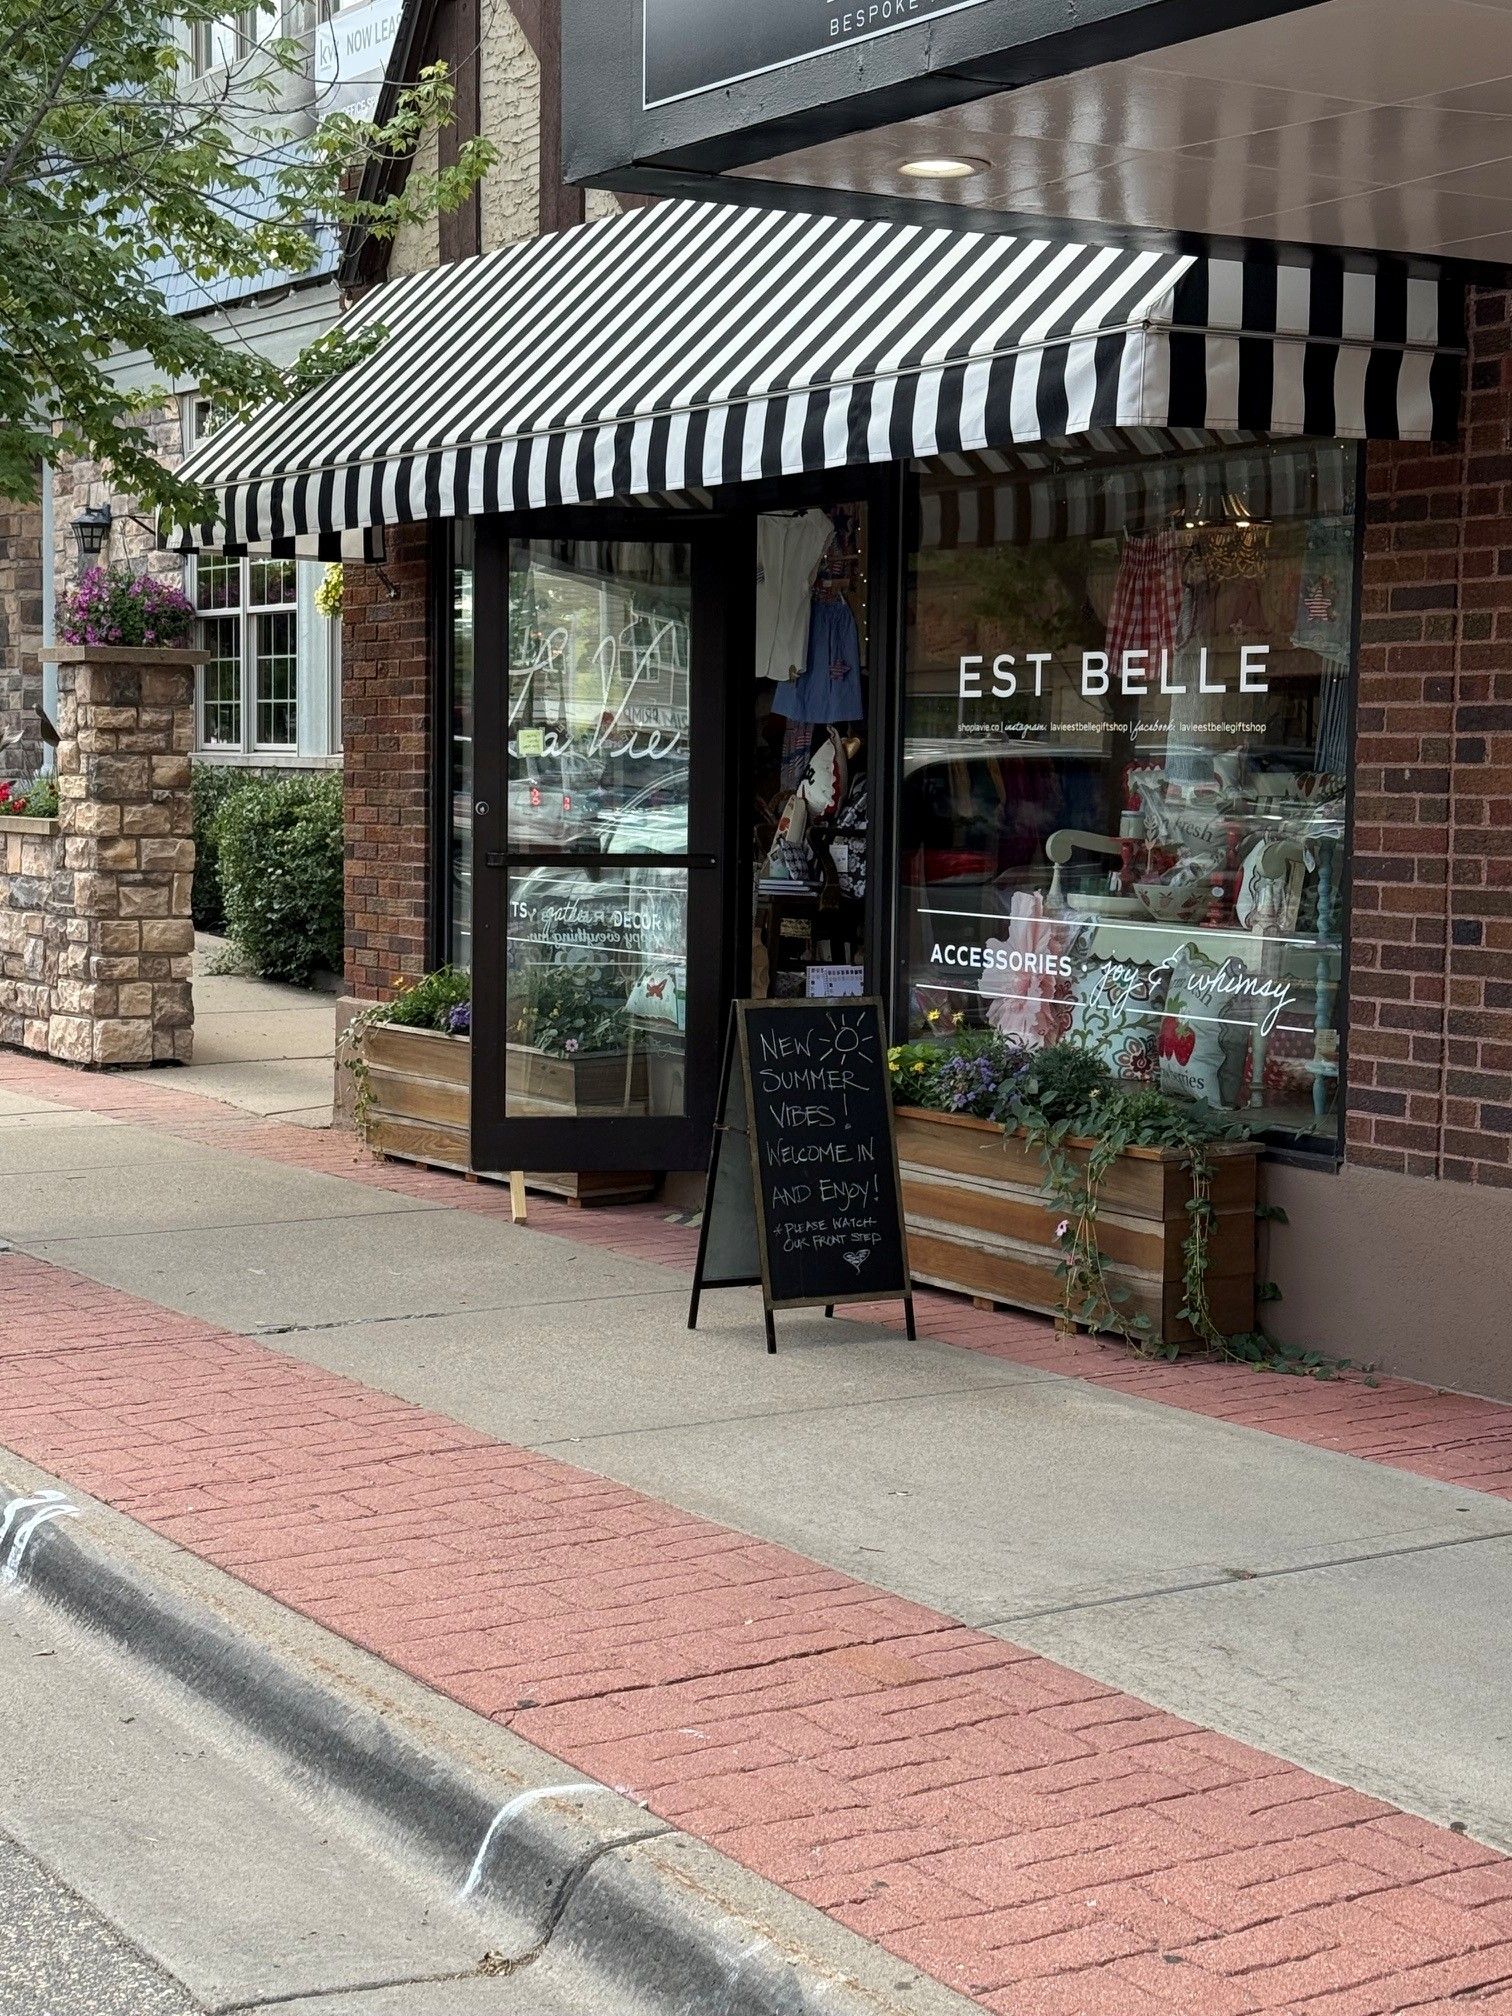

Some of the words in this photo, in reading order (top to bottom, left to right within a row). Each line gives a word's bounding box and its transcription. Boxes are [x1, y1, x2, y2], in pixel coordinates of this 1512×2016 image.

[346, 24, 373, 56] NOW
[958, 652, 1053, 699] EST
[1081, 645, 1270, 697] BELLE
[1050, 721, 1128, 734] lavieestbellegiftshop
[1179, 721, 1267, 734] lavieestbellegiftshop
[930, 943, 1072, 977] ACCESSORIES
[1089, 950, 1144, 1018] joy
[1188, 958, 1296, 1036] whimsy
[760, 1028, 815, 1062] NEW
[759, 1068, 870, 1092] SUMMER
[767, 1138, 852, 1167] WELCOME
[857, 1137, 875, 1161] IN
[772, 1185, 811, 1209] AND
[832, 1217, 877, 1229] WATCH
[783, 1237, 810, 1252] OUR
[814, 1234, 845, 1249] FRONT
[851, 1233, 881, 1246] STEP
